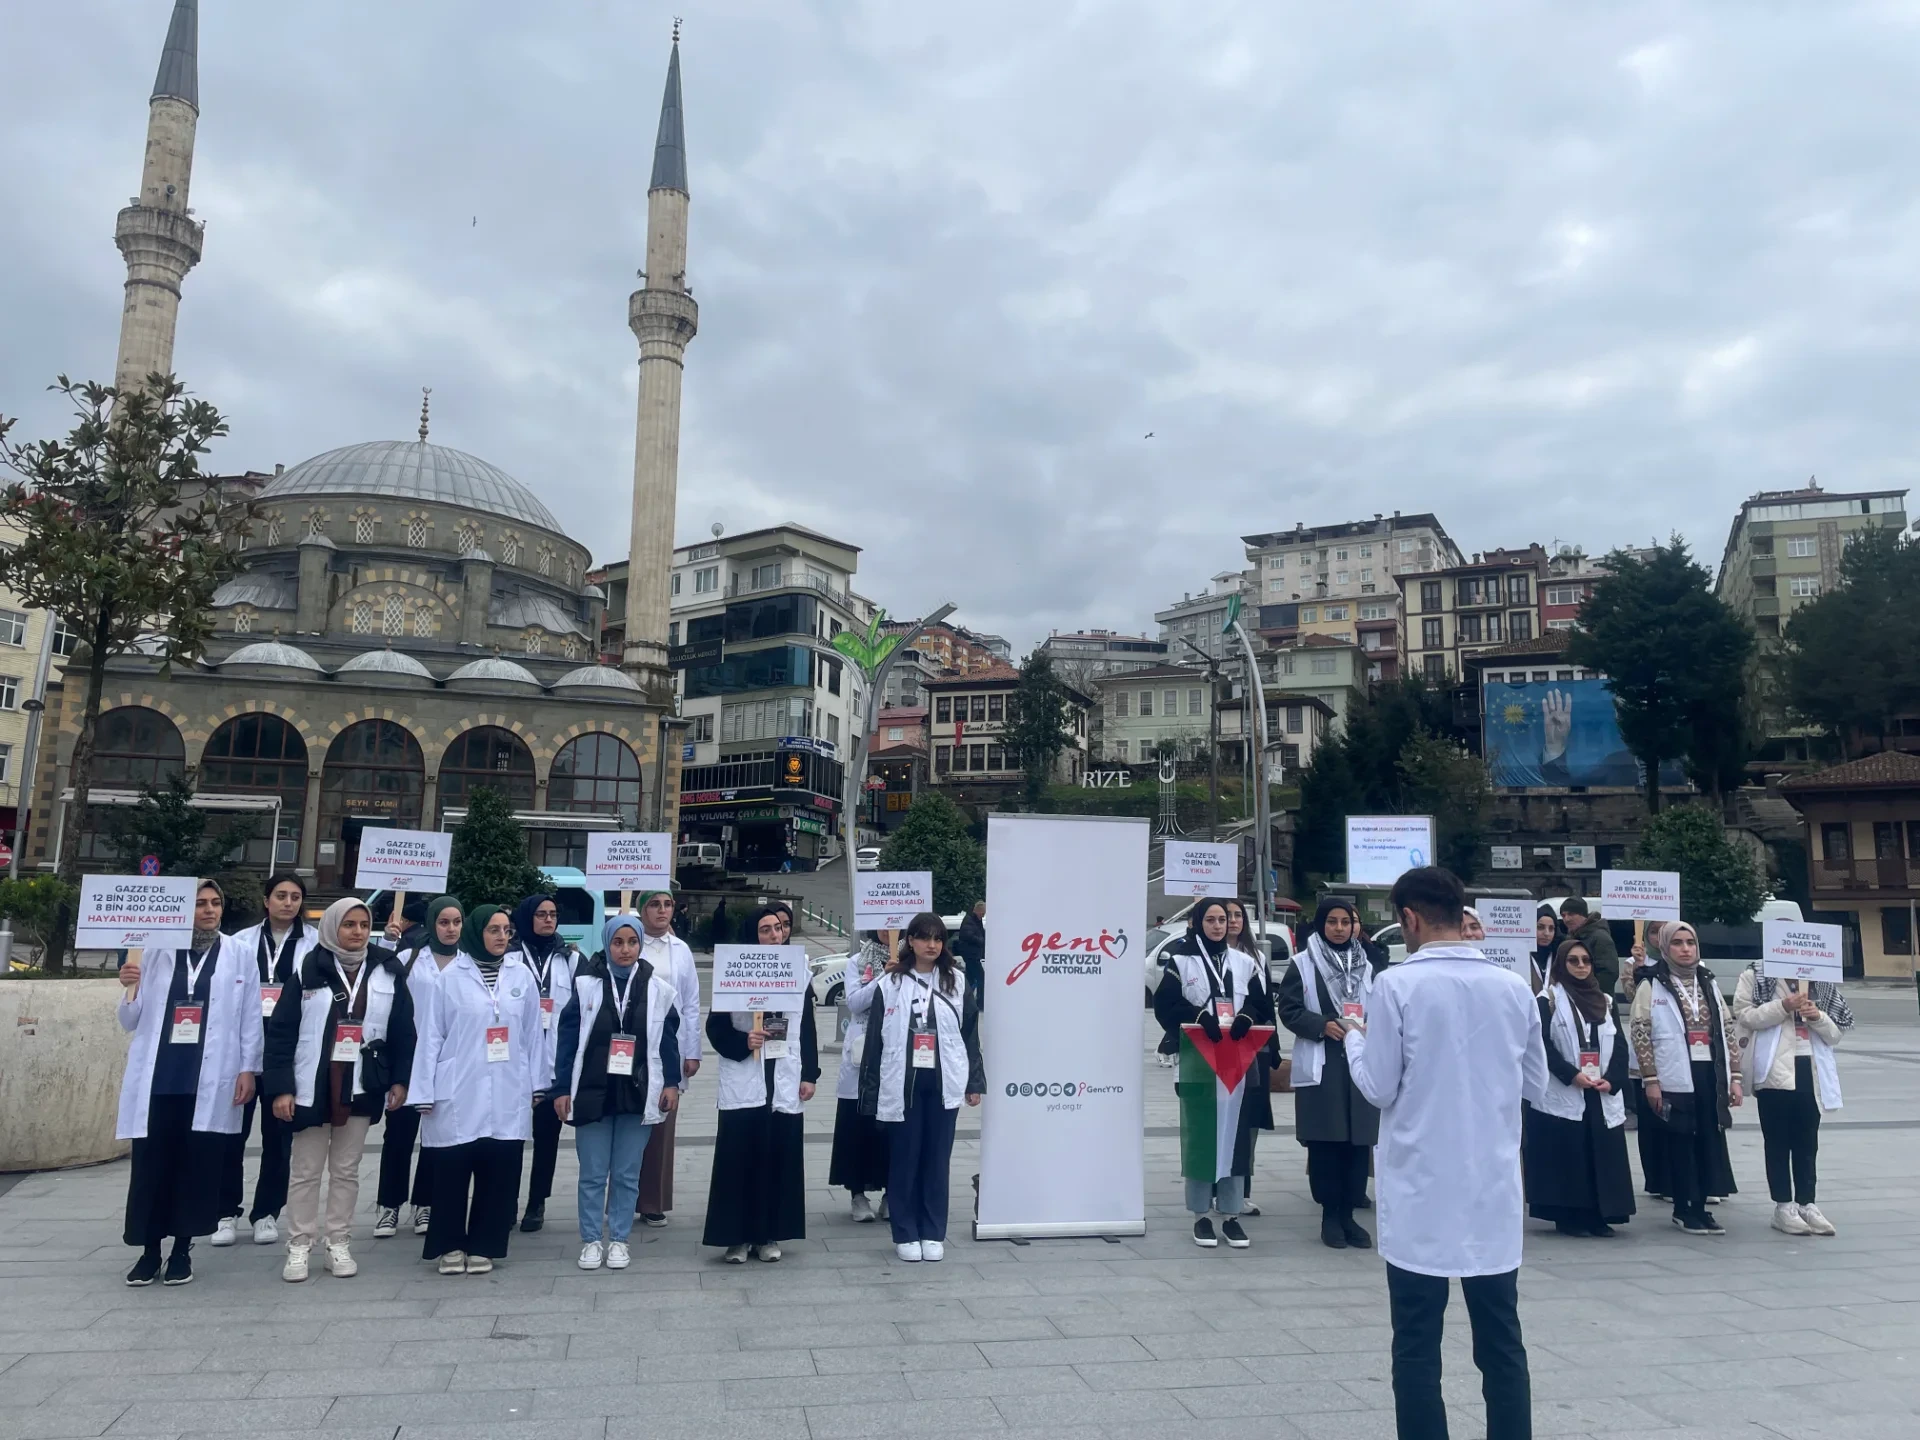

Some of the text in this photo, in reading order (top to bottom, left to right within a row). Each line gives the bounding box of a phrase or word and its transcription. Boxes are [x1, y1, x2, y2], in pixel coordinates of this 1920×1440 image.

[700, 811, 735, 820] YILMAZ
[386, 841, 426, 849] GAZZE'DE
[420, 851, 435, 859] KİŞİ
[366, 856, 442, 868] HAYATINI KAYBETTİ
[106, 893, 124, 902] BİN
[149, 895, 186, 904] ÇOCUK
[106, 903, 123, 911] BİN
[139, 915, 186, 924] KAYBETTİ
[1786, 932, 1821, 940] GAZZE'DE
[1793, 940, 1826, 948] HASTANE
[1772, 947, 1799, 955] HİZMET
[1042, 953, 1101, 965] YERYÜZÜ
[1042, 966, 1101, 974] DOKTORLARI
[1046, 1103, 1082, 1112] yyd.org.tr
